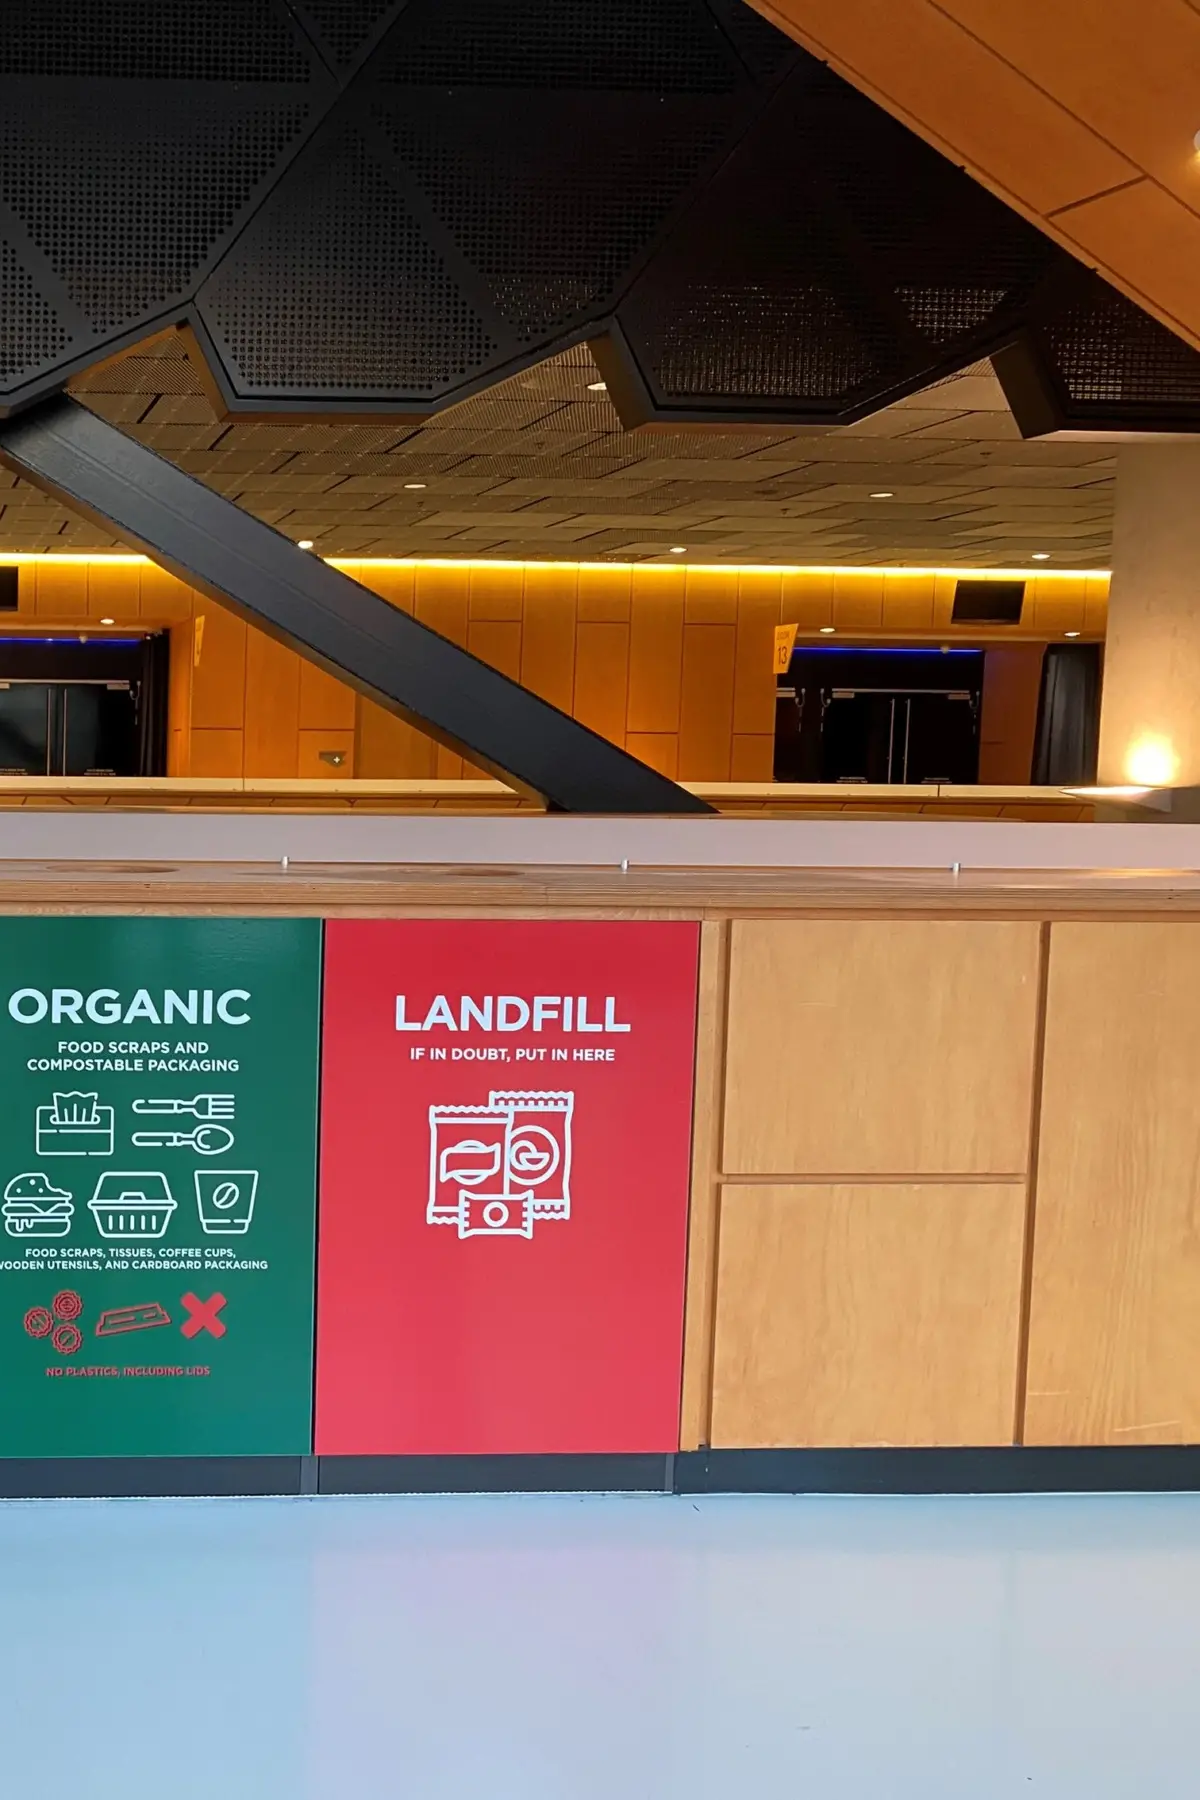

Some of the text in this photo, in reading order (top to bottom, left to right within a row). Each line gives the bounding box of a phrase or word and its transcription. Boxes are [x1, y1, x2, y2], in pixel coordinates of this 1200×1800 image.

[778, 646, 788, 665] 13
[8, 988, 252, 1025] ORGANIC
[395, 995, 631, 1032] LANDFILL
[58, 1041, 209, 1054] FOOD SCRAPS AND
[410, 1048, 615, 1062] IF IN DOUBT, PUT IN HERE
[27, 1058, 240, 1072] COMPOSTABLE PACKAGING
[25, 1248, 236, 1259] FOOD SCRAPS, TISSUES, COFFEE CUPS,
[47, 1260, 102, 1271] UTENSILS,
[105, 1260, 129, 1270] AND
[131, 1260, 201, 1270] CARDBOARD
[204, 1260, 268, 1270] PACKAGING
[46, 1366, 210, 1378] NO PLASTICS, INCLUDING LIDS
